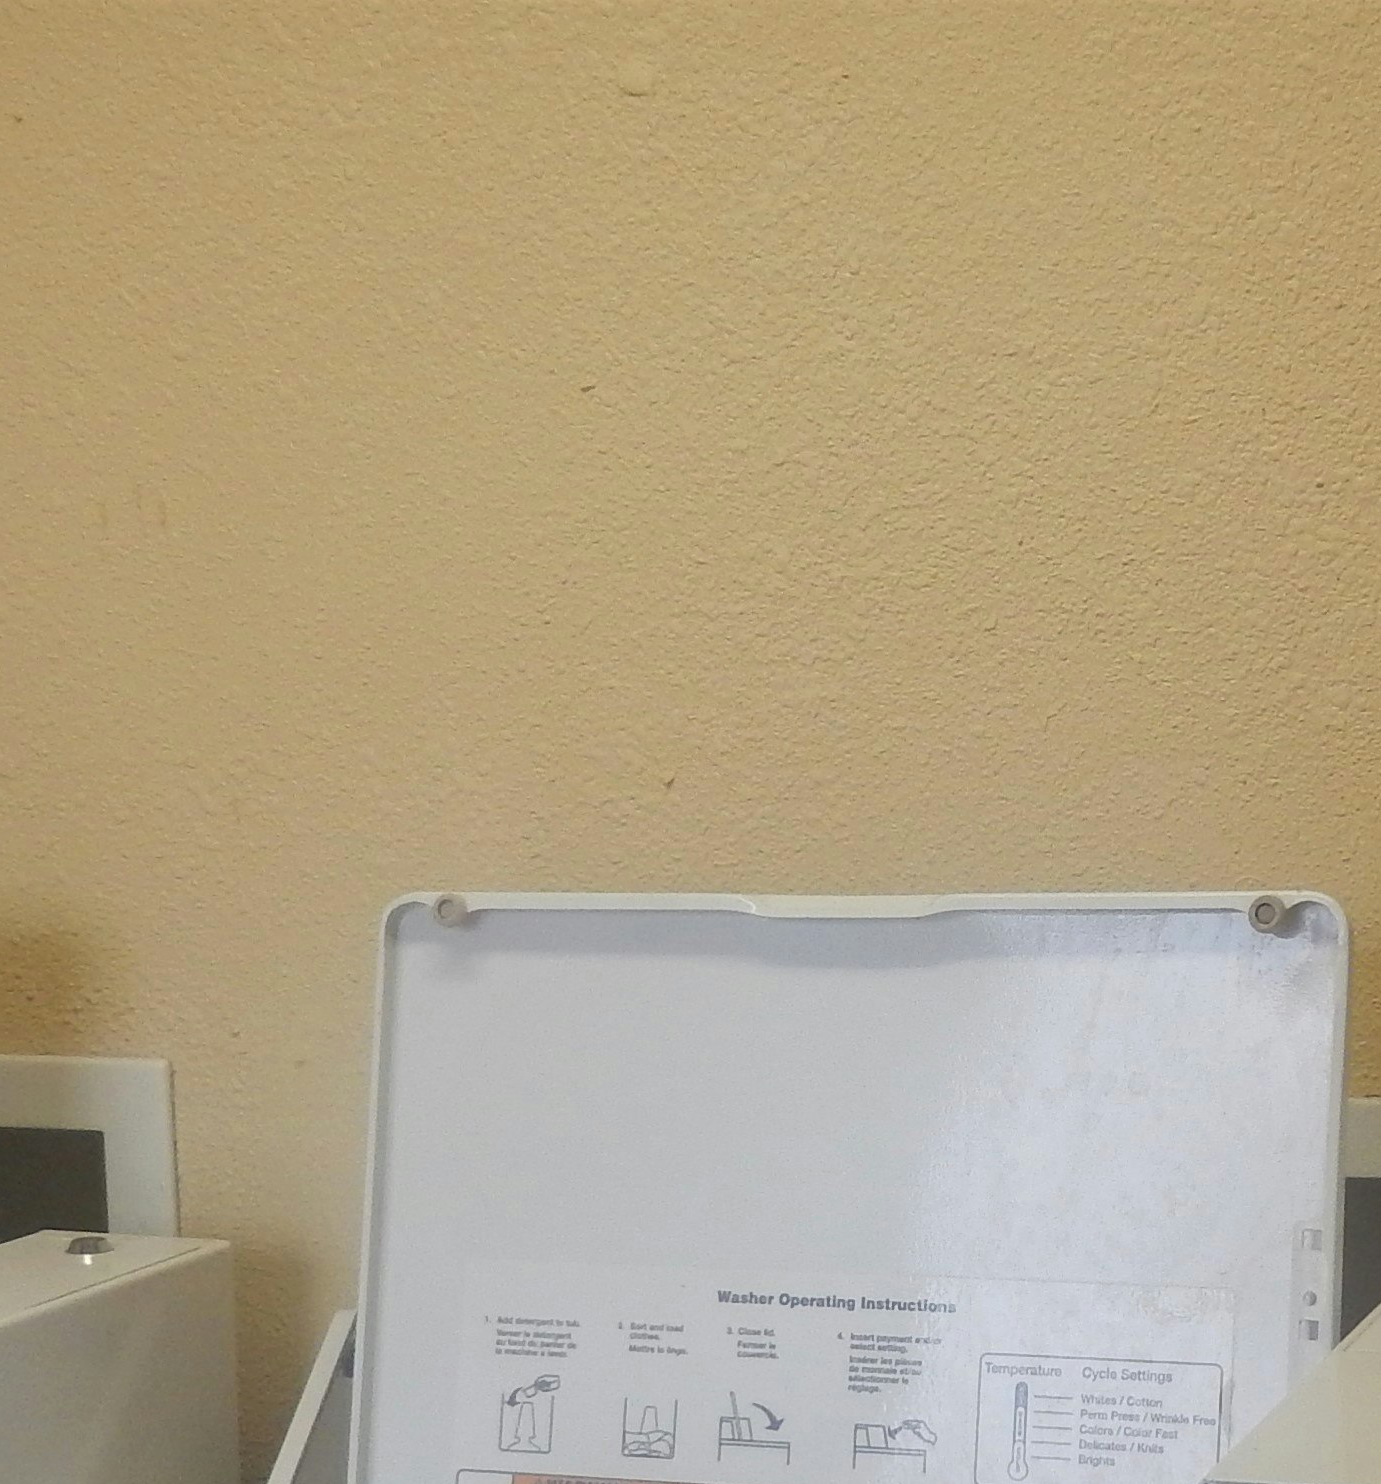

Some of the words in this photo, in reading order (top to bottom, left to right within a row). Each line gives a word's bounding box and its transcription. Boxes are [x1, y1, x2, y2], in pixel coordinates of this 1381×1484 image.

[716, 1290, 774, 1305] Washer
[778, 1293, 855, 1311] Operating
[861, 1296, 956, 1313] Instructions
[984, 1361, 1062, 1379] Temperature
[1081, 1366, 1117, 1382] Cycle
[1120, 1368, 1173, 1383] Settings
[1080, 1393, 1117, 1405] Whites
[1118, 1395, 1124, 1406] /
[1126, 1396, 1163, 1408] Cotton
[1080, 1409, 1107, 1420] Perm
[1110, 1410, 1140, 1422] Press
[1142, 1412, 1148, 1422] /
[1151, 1413, 1189, 1425] Wrinkle
[1192, 1415, 1216, 1426] Free
[1079, 1424, 1114, 1436] Colors
[1116, 1426, 1121, 1436] /
[1123, 1426, 1153, 1438] Color
[1155, 1428, 1178, 1440] Fast
[1078, 1439, 1126, 1452] Delicates
[1129, 1442, 1135, 1452] /
[1137, 1442, 1164, 1454] Knits
[1077, 1455, 1115, 1467] Brights
